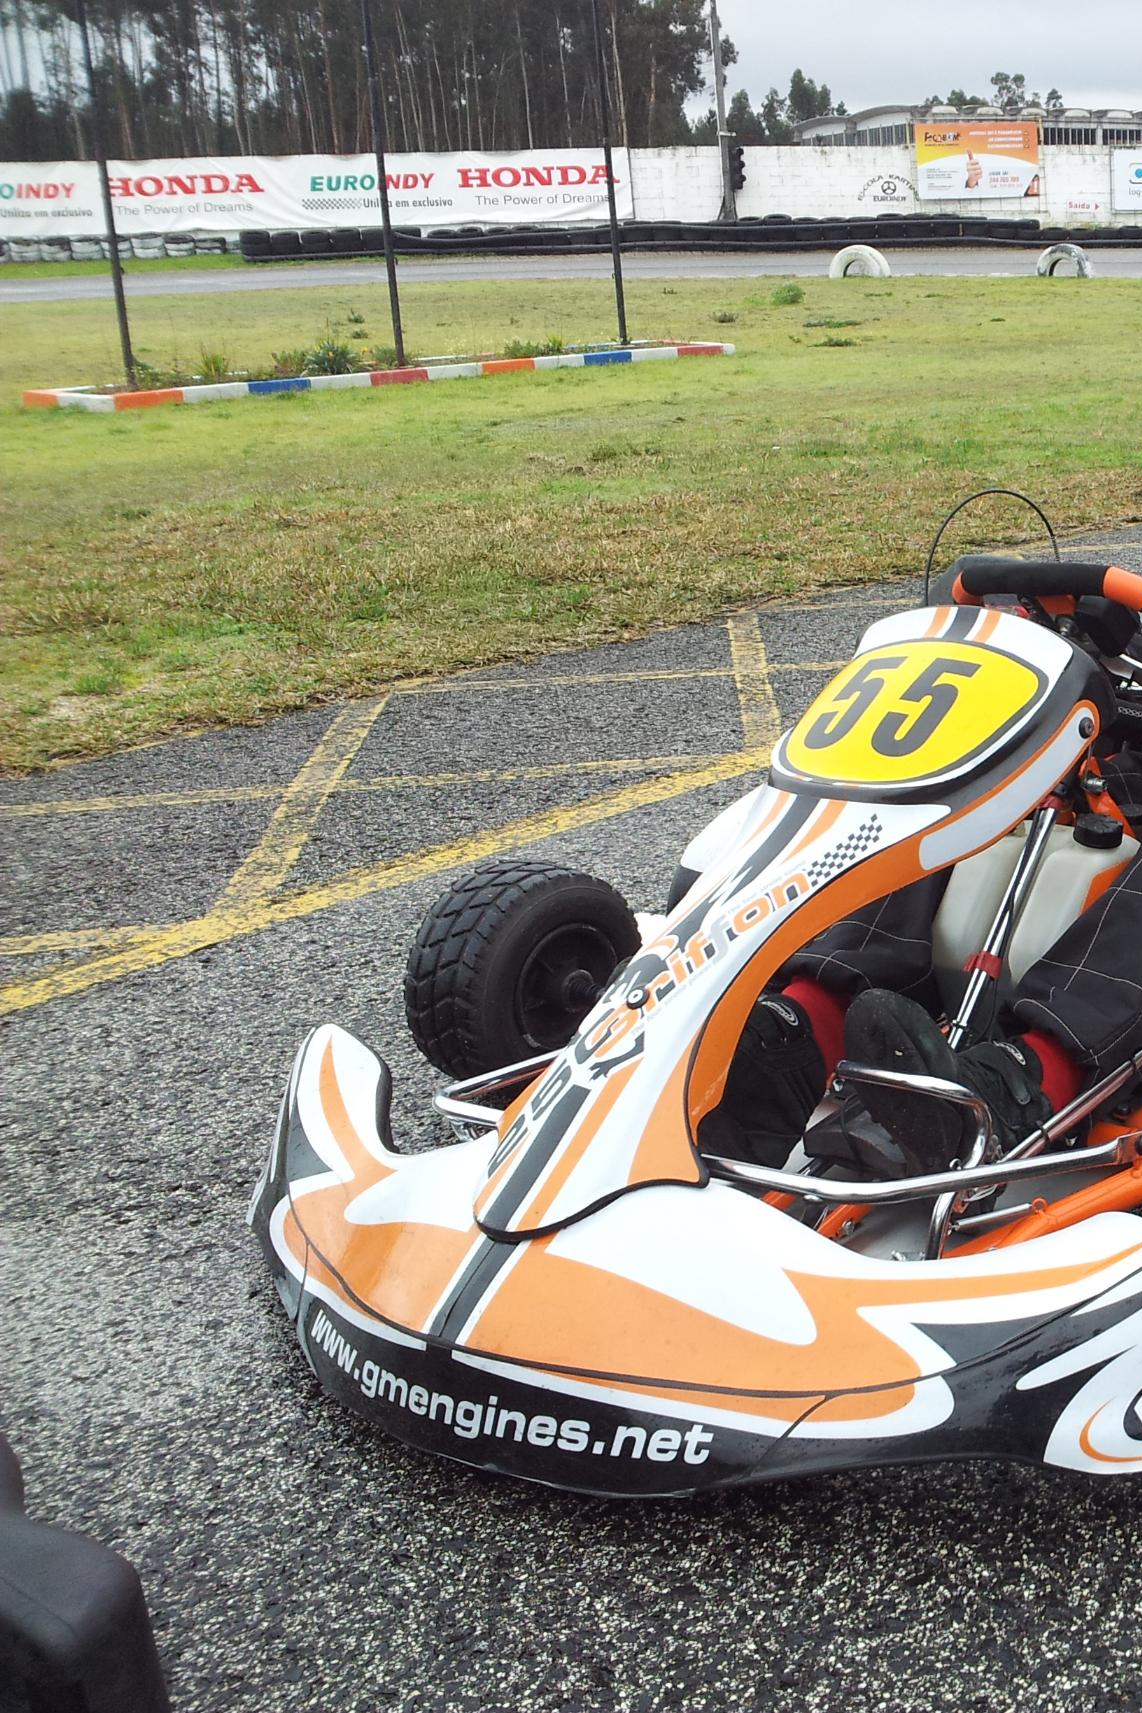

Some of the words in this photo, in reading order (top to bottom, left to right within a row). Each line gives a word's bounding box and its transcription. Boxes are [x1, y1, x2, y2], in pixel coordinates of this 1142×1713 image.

[108, 174, 265, 197] HONDA
[310, 173, 435, 192] EURONDY
[456, 165, 620, 188] HONDA
[117, 204, 139, 216] The
[144, 203, 184, 216] Power
[188, 202, 200, 214] of
[204, 201, 254, 214] Dreams
[395, 200, 410, 208] em
[412, 196, 453, 208] exclusivo
[475, 195, 500, 206] The
[504, 194, 543, 205] Power
[547, 193, 558, 204] of
[803, 655, 982, 758] 55
[310, 1308, 714, 1465] www.gmengines.net
